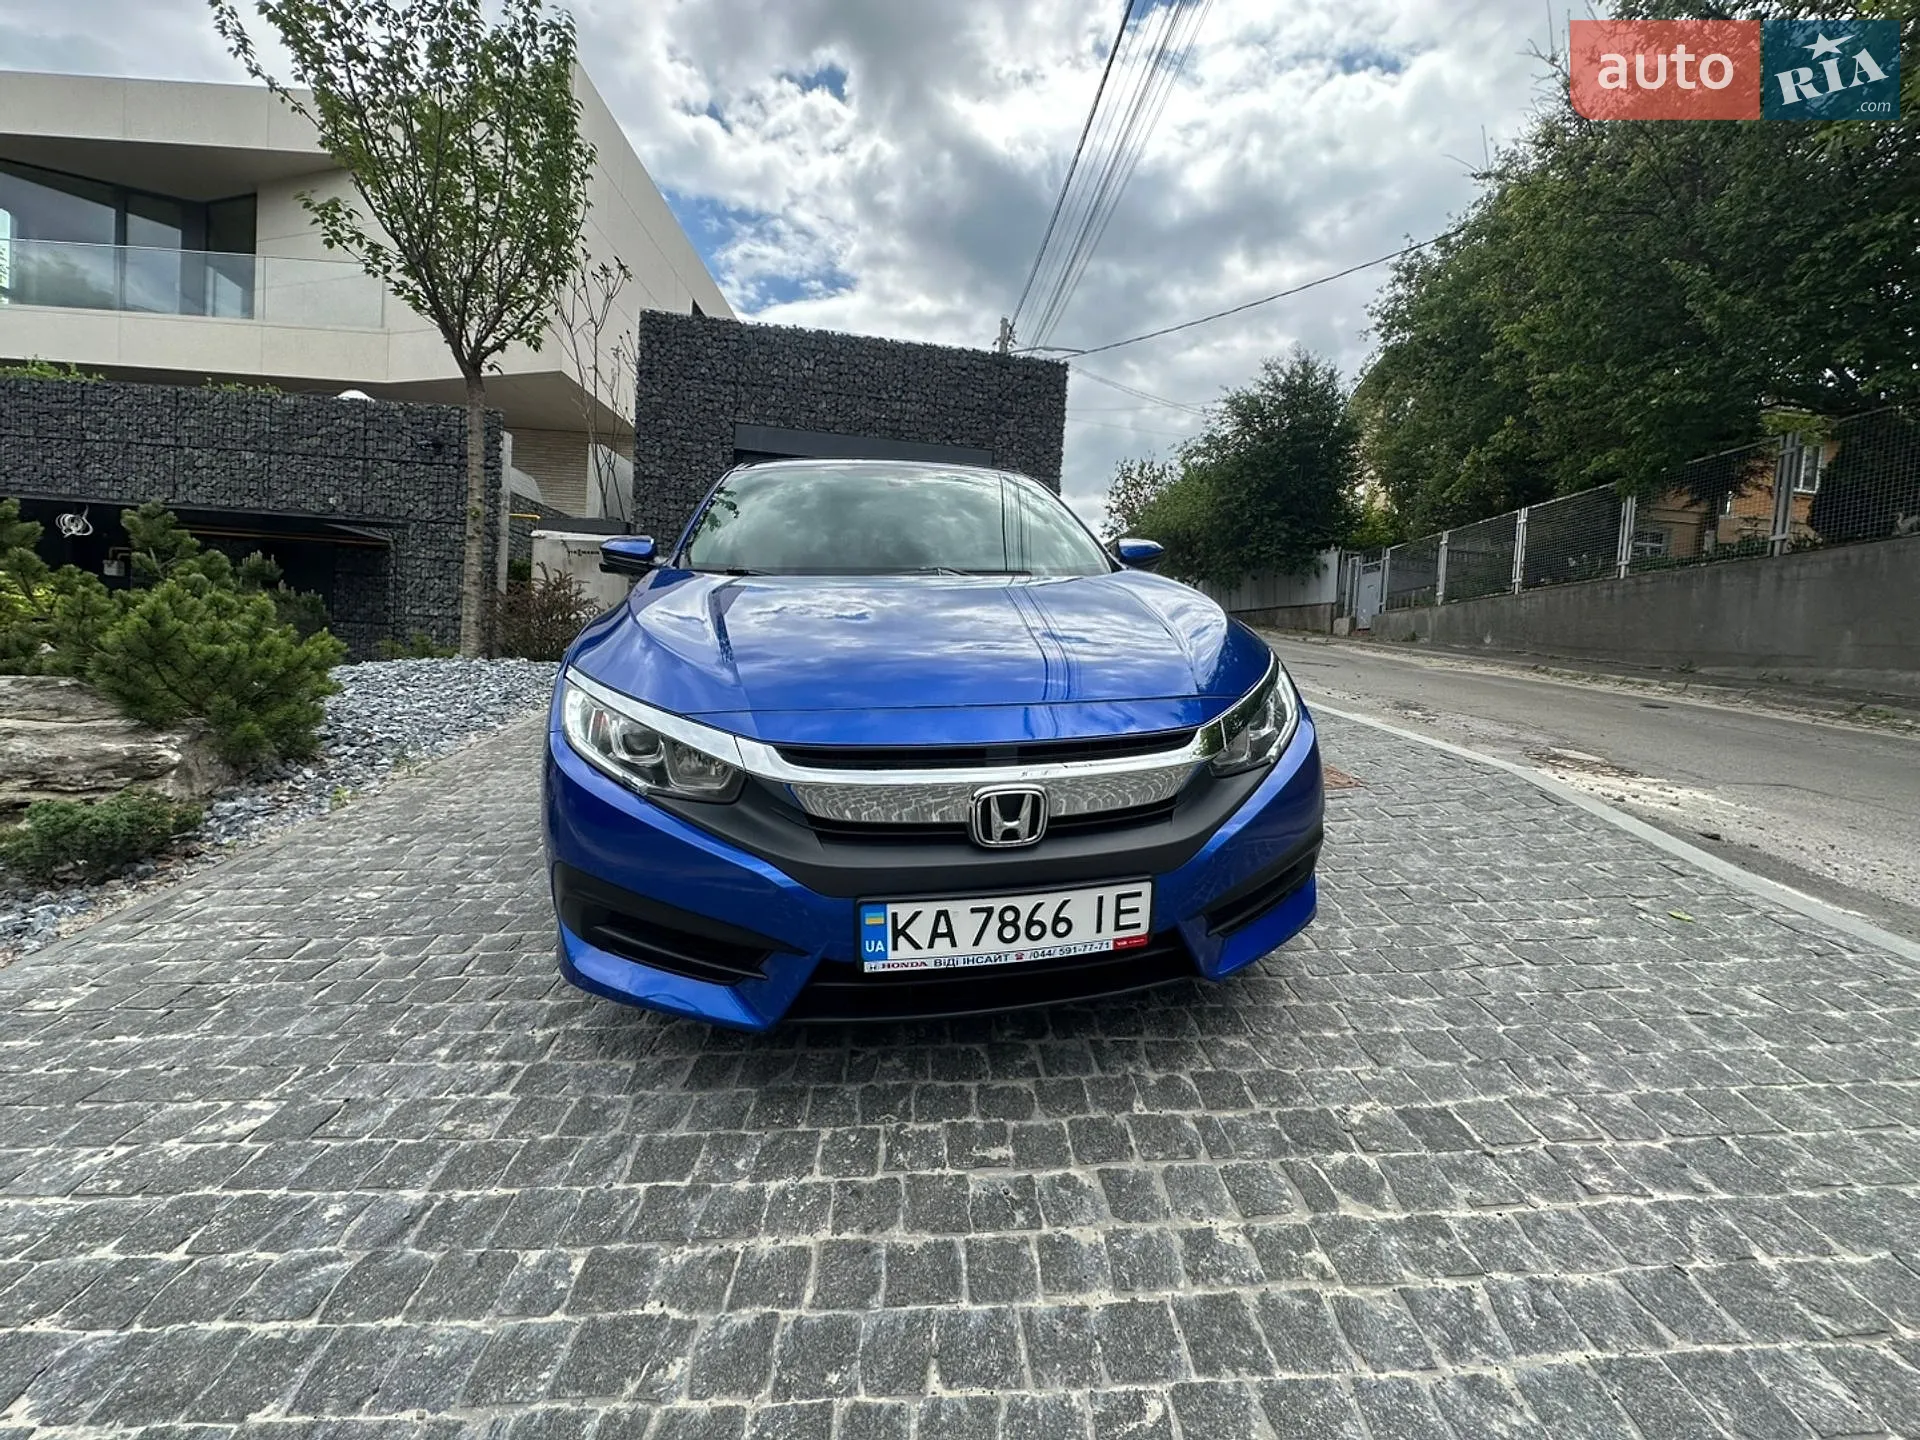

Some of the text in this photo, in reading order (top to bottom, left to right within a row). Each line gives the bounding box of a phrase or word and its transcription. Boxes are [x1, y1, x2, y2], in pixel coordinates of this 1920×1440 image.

[890, 890, 1143, 952] KA 7866 IE
[865, 940, 886, 952] UA
[881, 960, 929, 970] HONDA
